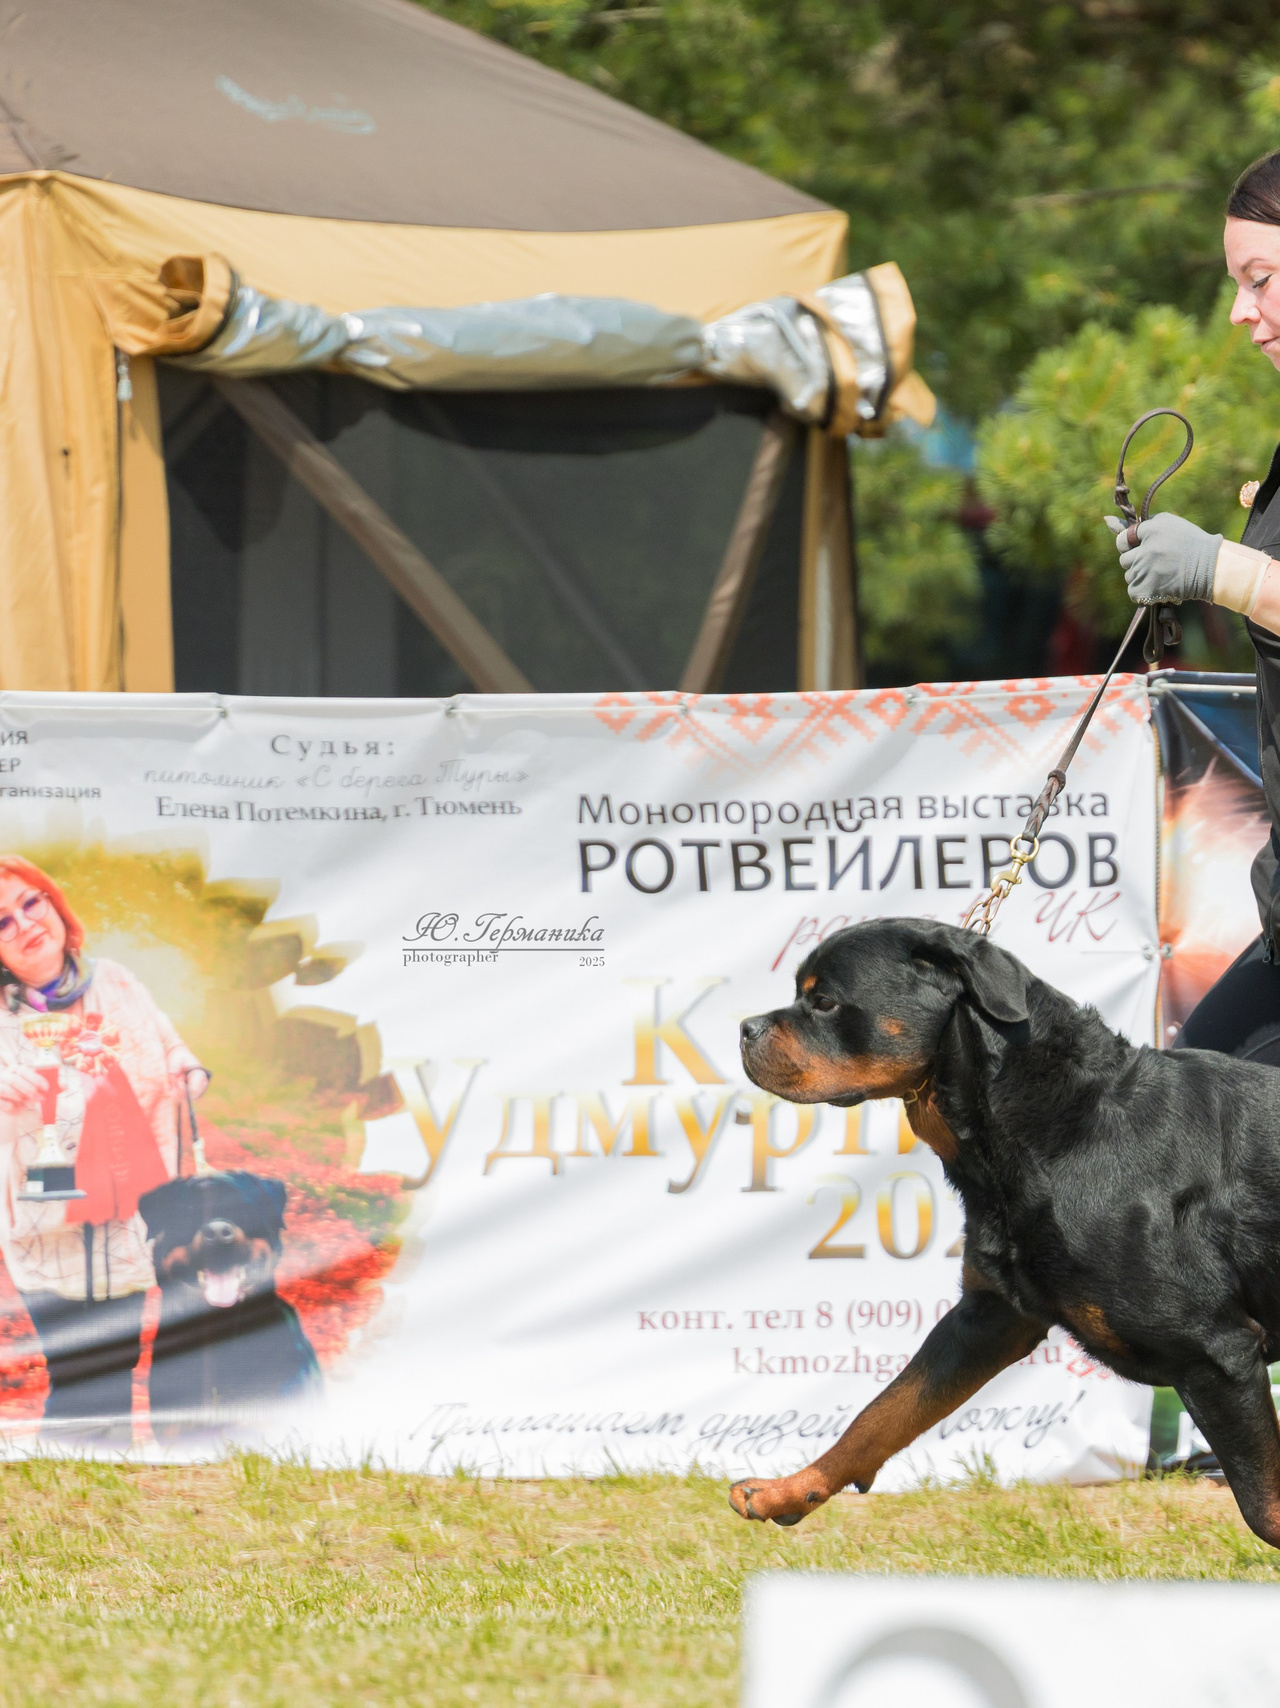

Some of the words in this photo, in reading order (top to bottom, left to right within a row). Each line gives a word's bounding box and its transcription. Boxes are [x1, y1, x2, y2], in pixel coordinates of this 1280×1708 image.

[270, 734, 395, 761] Судья:
[156, 796, 230, 819] Елена
[234, 801, 387, 823] Потемкина,
[393, 803, 411, 818] г.
[415, 796, 522, 816] Тюмень
[578, 793, 902, 834] Монопородная
[579, 819, 1121, 894] РОТВЕЙЛЕРОВ
[636, 1309, 734, 1330] конт.
[744, 1308, 806, 1330] тел
[816, 1300, 834, 1329] 8
[847, 1298, 922, 1335] (909)
